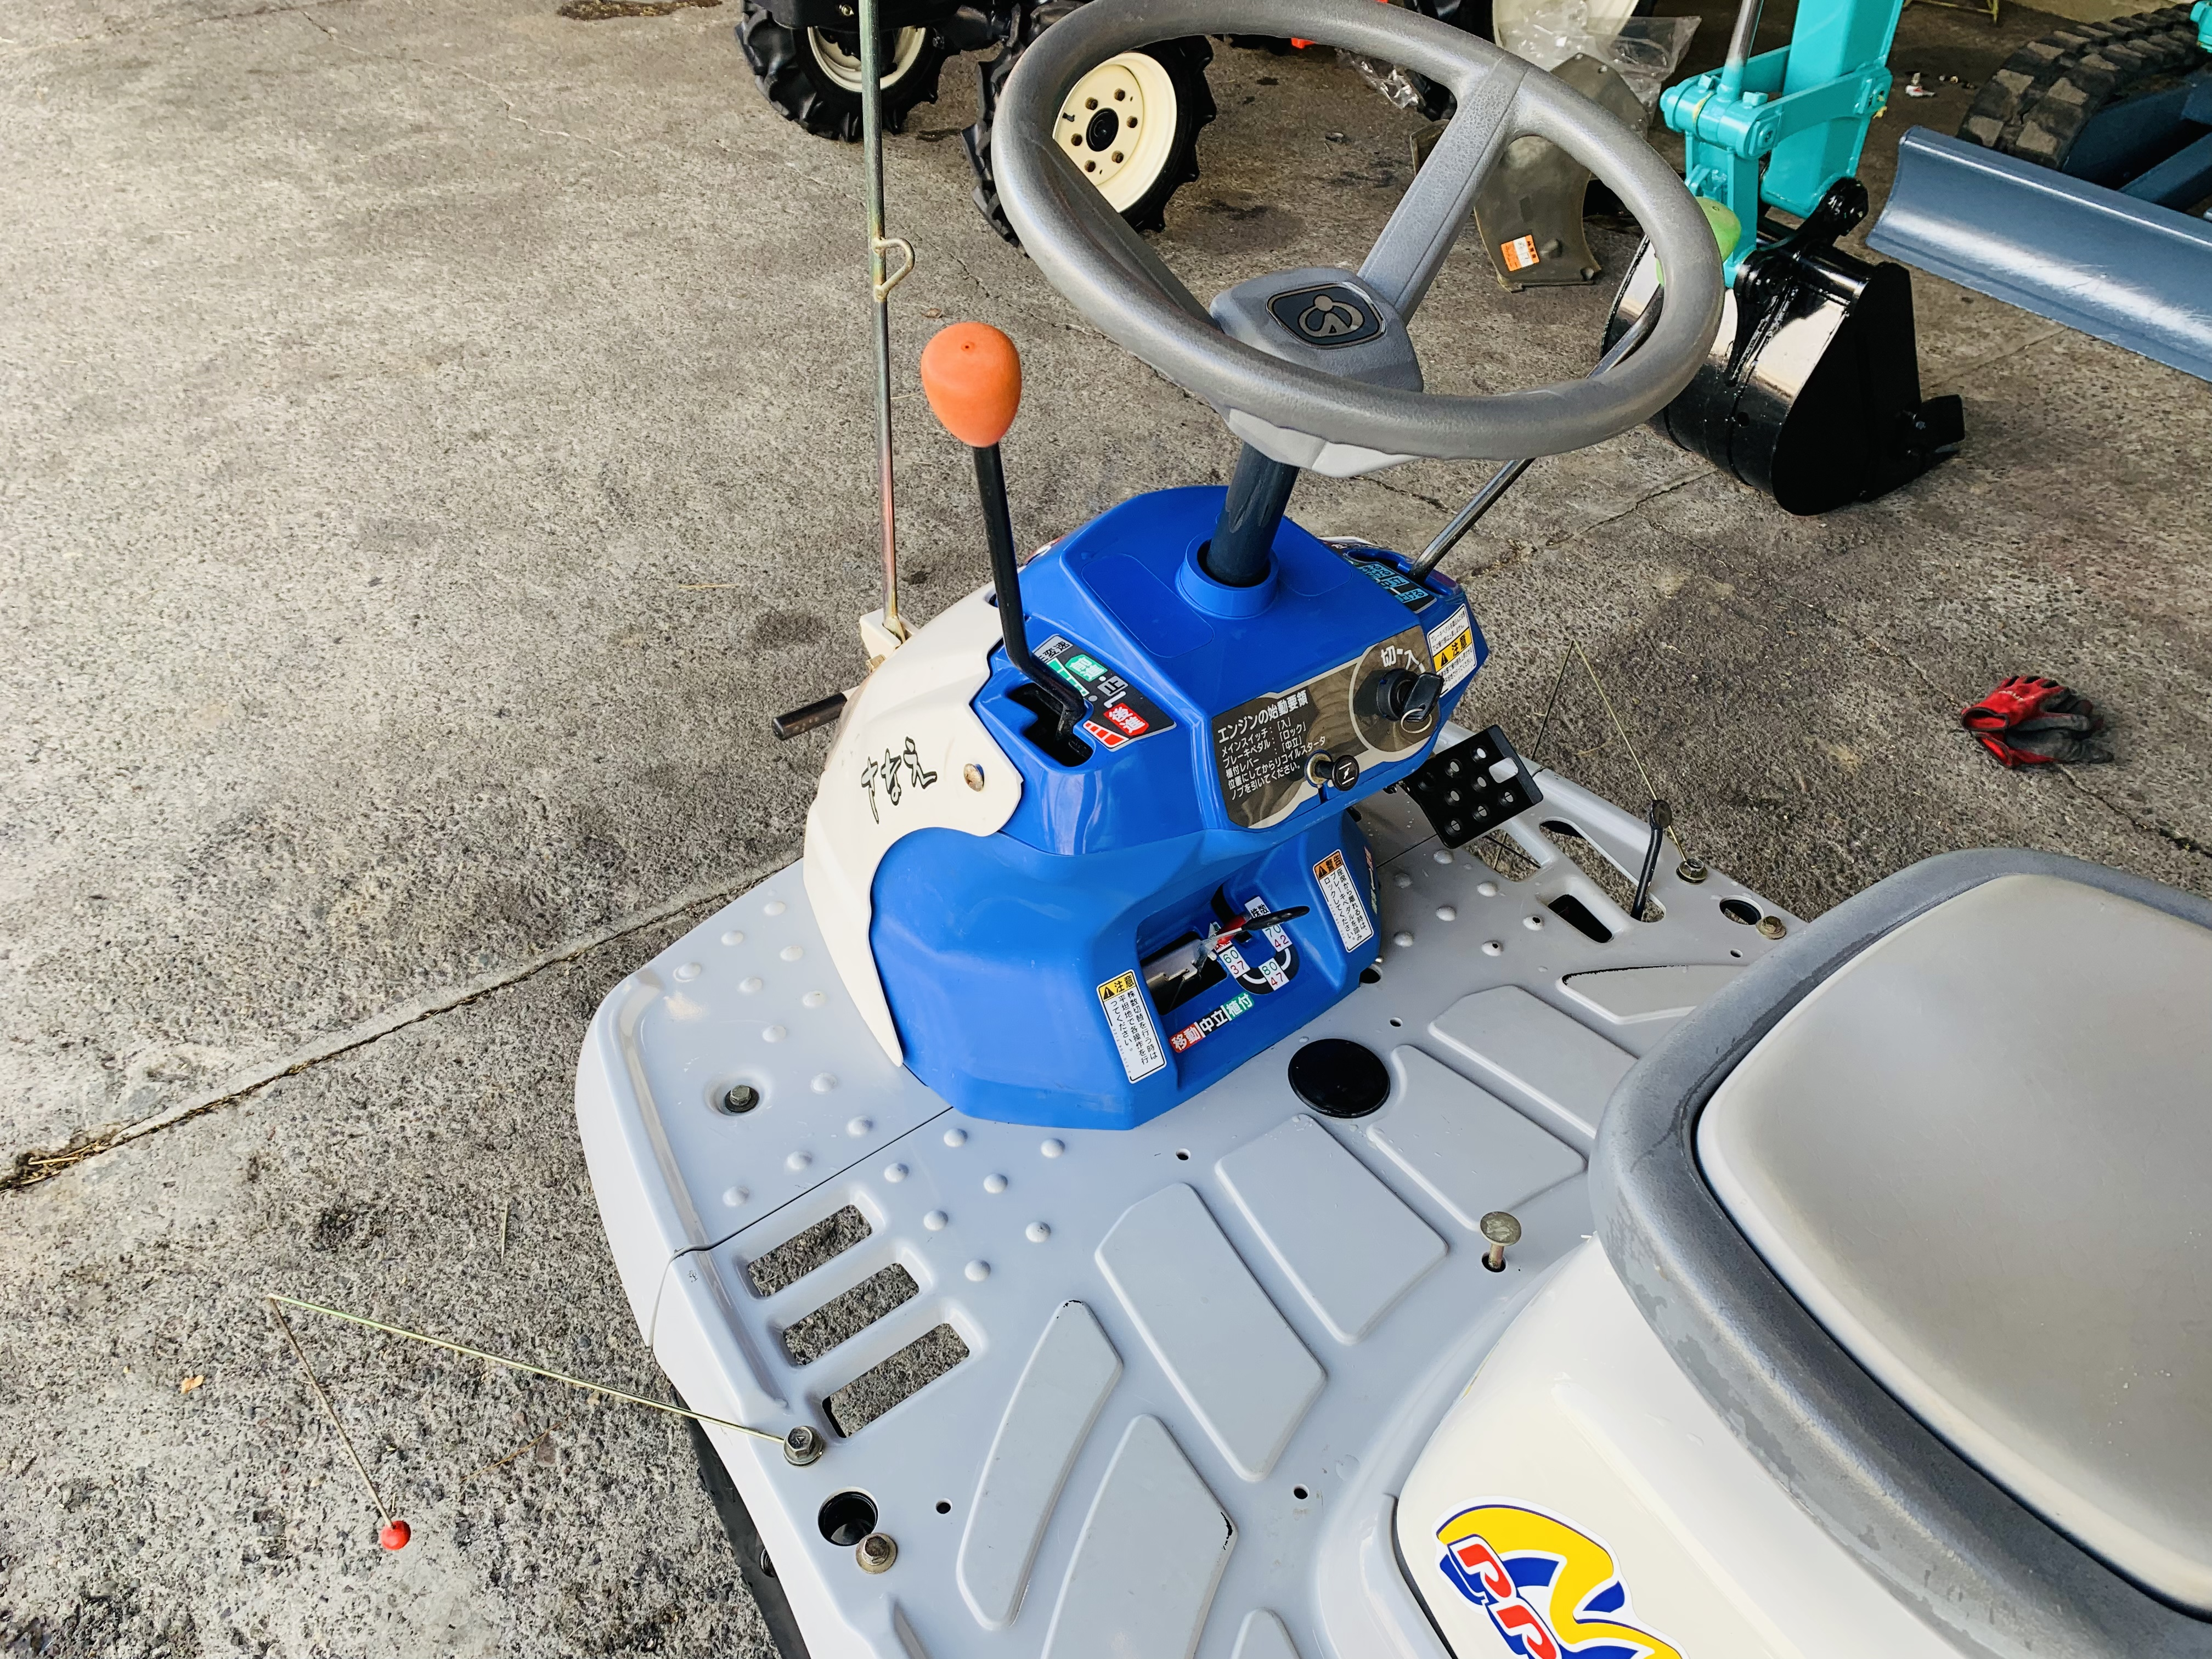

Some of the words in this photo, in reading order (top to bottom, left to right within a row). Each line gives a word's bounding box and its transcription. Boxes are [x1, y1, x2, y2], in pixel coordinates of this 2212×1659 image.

[1379, 577, 1406, 588] 中立
[1398, 590, 1425, 602] 上げる
[1452, 634, 1467, 657] 注意
[1069, 656, 1105, 680] 前進
[1380, 645, 1397, 667] 切
[1404, 650, 1420, 670] 入
[1104, 677, 1125, 694] 止
[1109, 706, 1146, 733] 後進
[1217, 690, 1308, 743] エンジンの始動要領
[1228, 736, 1325, 790] 位置にしてからリコイルスタータ
[1231, 761, 1300, 800] ノブを引いてください。
[1325, 855, 1343, 872] 警告
[1250, 904, 1269, 918] 株数
[1324, 877, 1355, 940] ロックしてください。
[1330, 871, 1362, 941] ブレーキペダルを踏み
[1336, 868, 1368, 931] 座席から離れる時は、
[1265, 925, 1281, 938] 70
[1274, 935, 1289, 948] 42
[1223, 950, 1239, 963] 60
[1231, 960, 1245, 974] 37
[1262, 961, 1278, 976] 80
[1270, 972, 1284, 986] 47
[1114, 975, 1134, 993] 注意
[1110, 1001, 1133, 1052] ってください。
[1119, 996, 1149, 1065] 平坦地で各操作を行
[1127, 991, 1158, 1059] 株数切替を行う時は
[1171, 1024, 1202, 1051] 移動
[1200, 1011, 1228, 1032] 中立
[1226, 992, 1254, 1017] 植付
